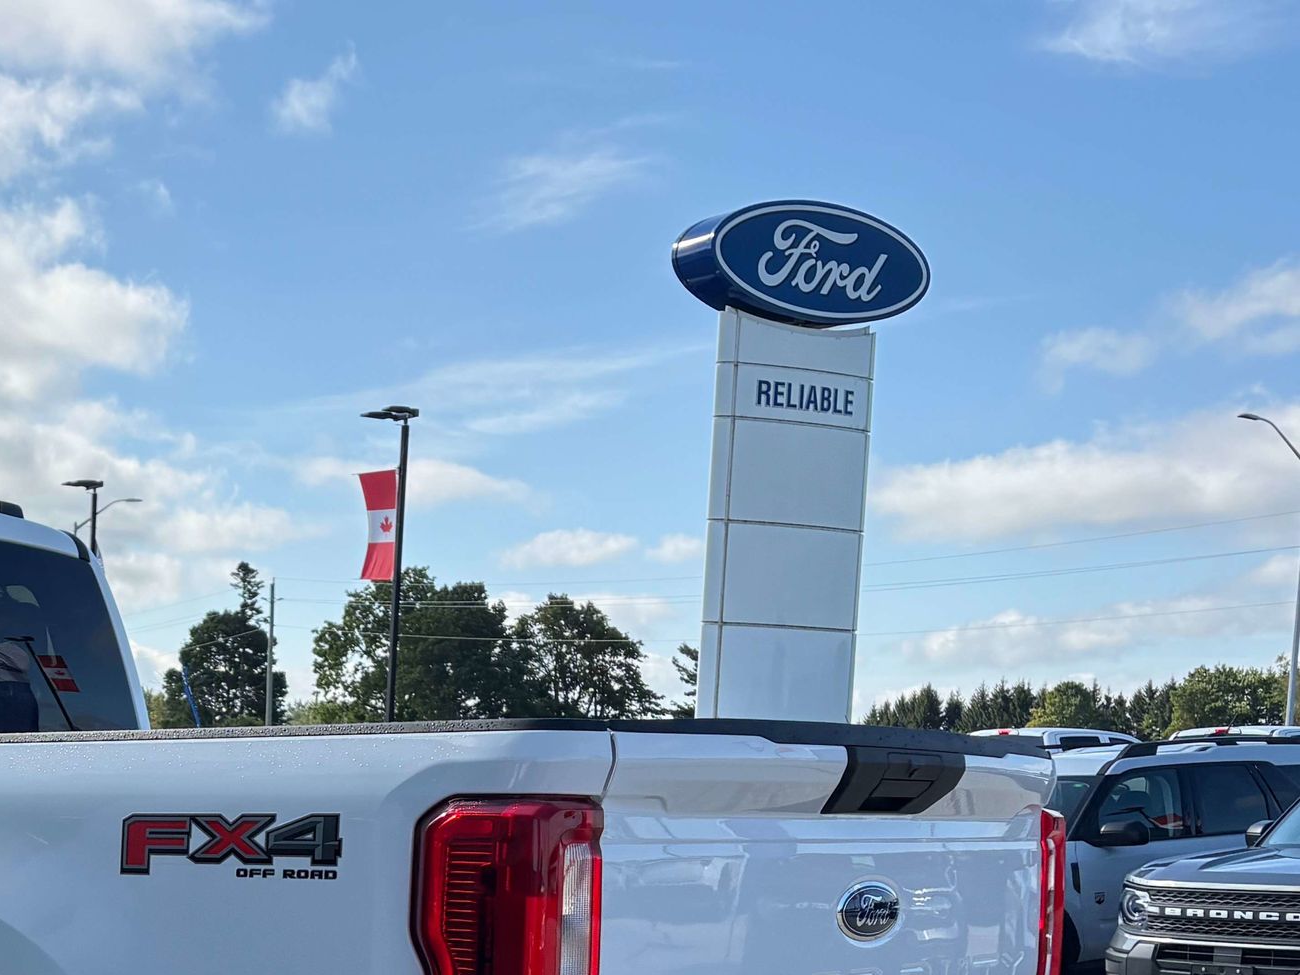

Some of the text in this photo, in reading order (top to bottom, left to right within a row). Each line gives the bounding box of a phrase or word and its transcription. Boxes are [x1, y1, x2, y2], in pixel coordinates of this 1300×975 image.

[757, 218, 889, 302] Ford
[755, 379, 855, 416] RELIABLE
[120, 812, 343, 875] FX4
[236, 868, 338, 880] OFF ROAD
[856, 894, 891, 927] Ford
